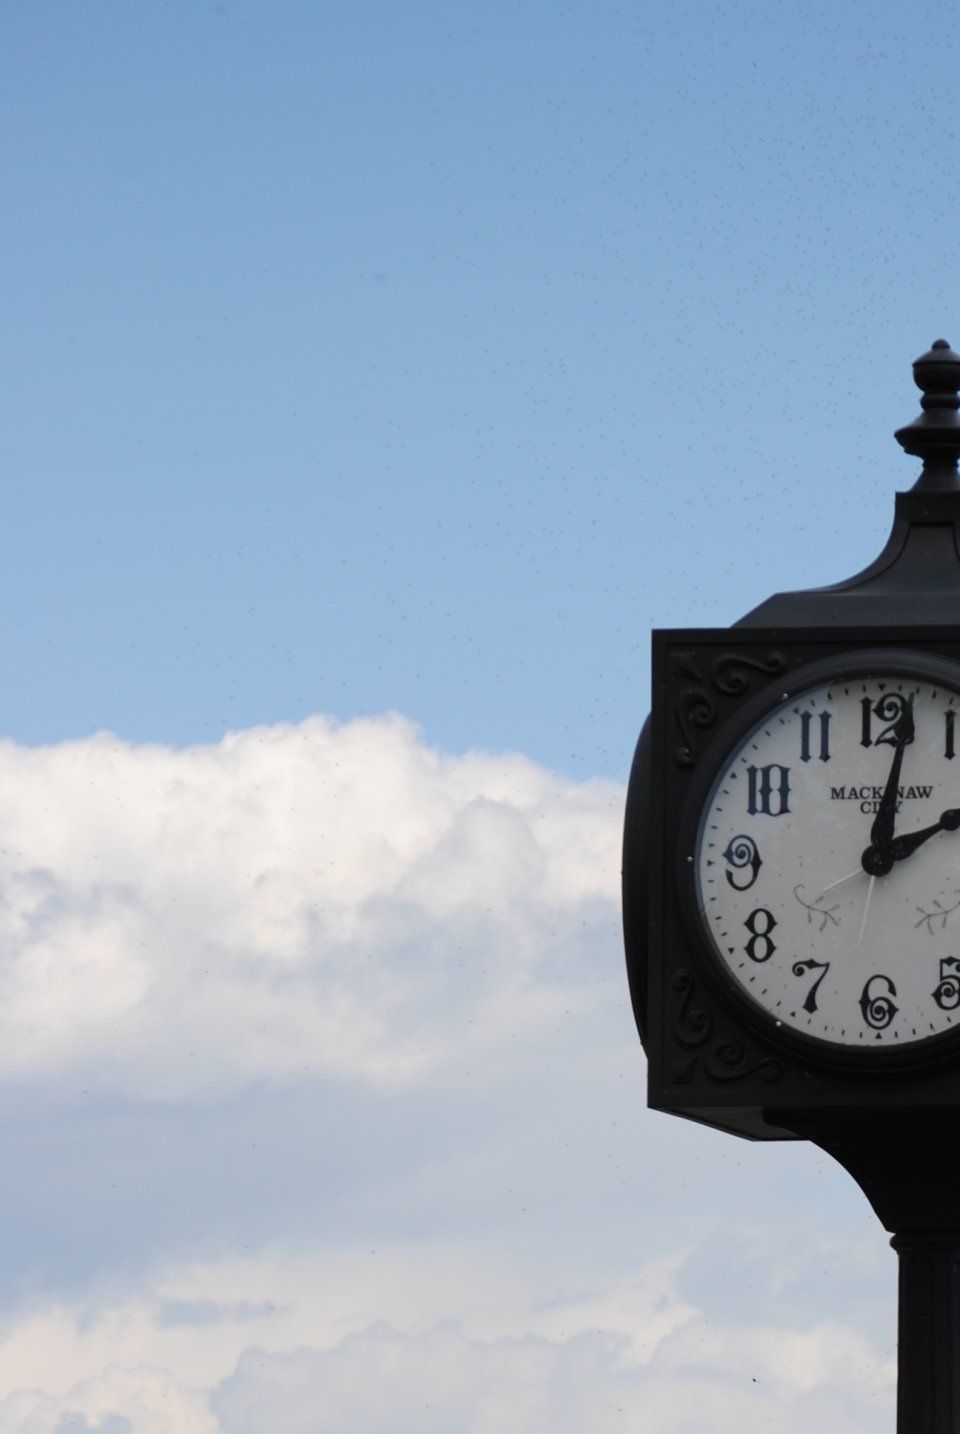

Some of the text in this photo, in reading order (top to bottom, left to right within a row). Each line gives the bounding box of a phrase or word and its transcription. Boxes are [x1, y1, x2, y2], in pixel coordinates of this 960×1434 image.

[800, 710, 831, 763] 11
[860, 692, 915, 748] 12
[944, 709, 957, 760] 1
[746, 764, 792, 817] 10
[830, 785, 933, 800] MACKNAW
[860, 801, 903, 814] CIY
[723, 834, 763, 891] 9
[743, 908, 778, 963] 8
[792, 958, 830, 1014] 7
[858, 974, 899, 1030] 6
